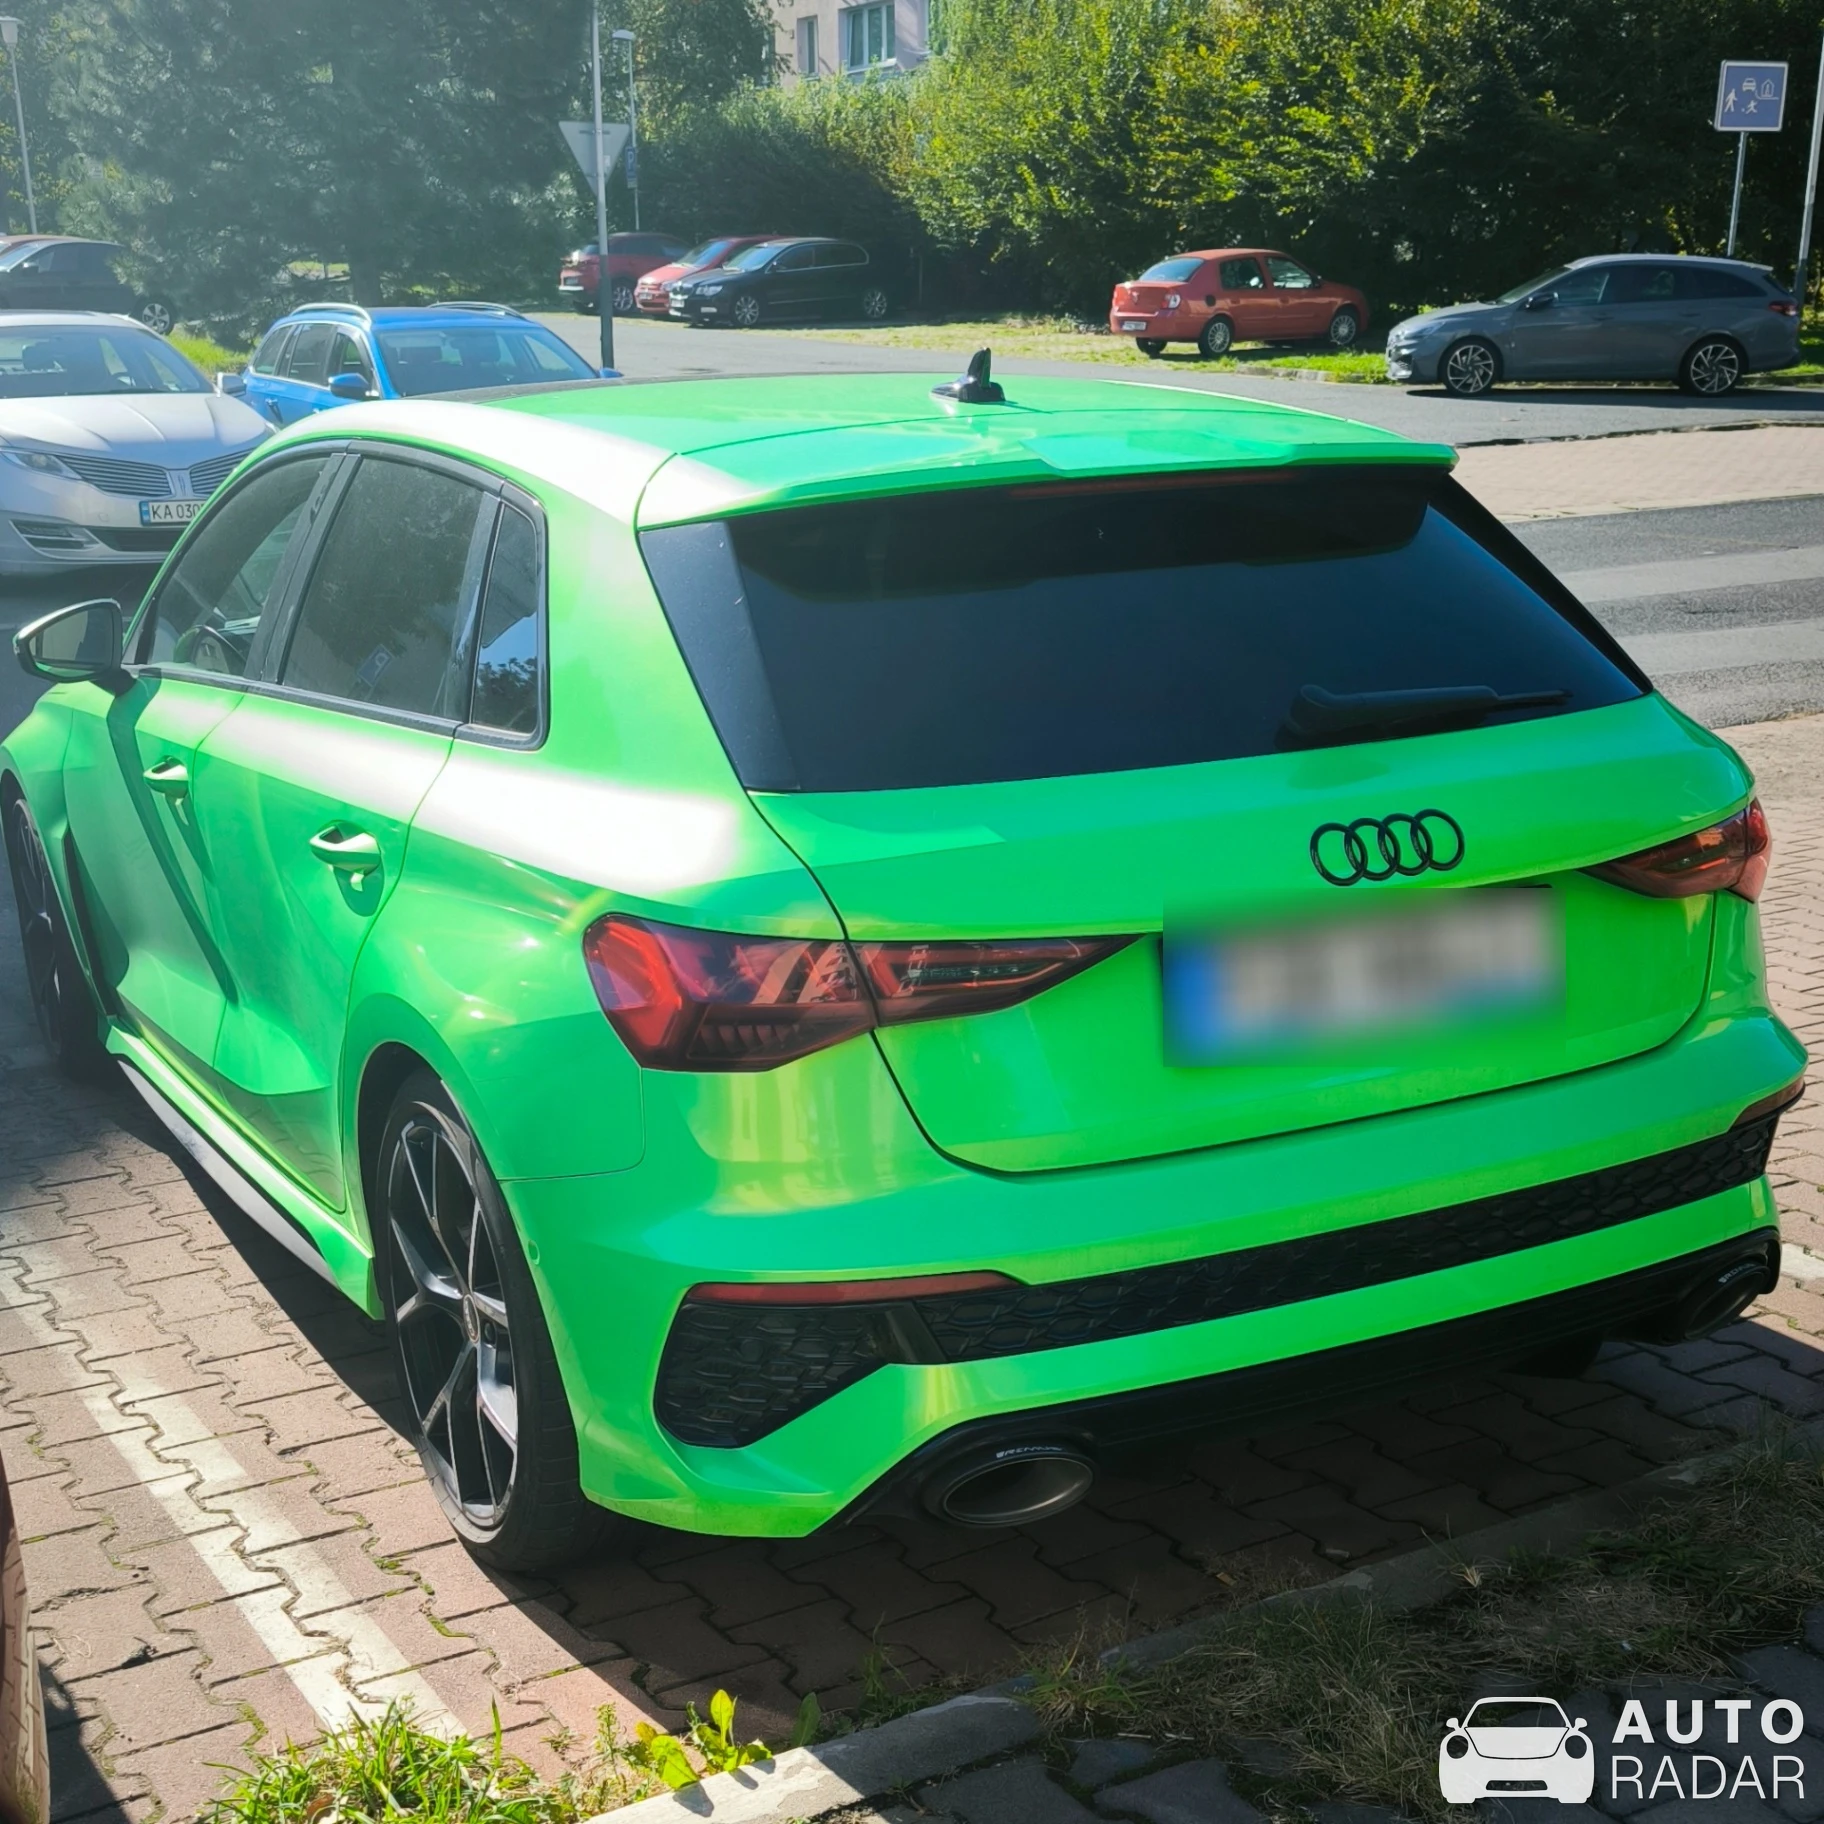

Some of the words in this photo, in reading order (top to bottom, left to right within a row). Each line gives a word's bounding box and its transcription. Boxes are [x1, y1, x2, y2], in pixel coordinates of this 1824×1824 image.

[627, 151, 635, 170] P
[152, 504, 173, 520] KA
[176, 503, 204, 519] 030
